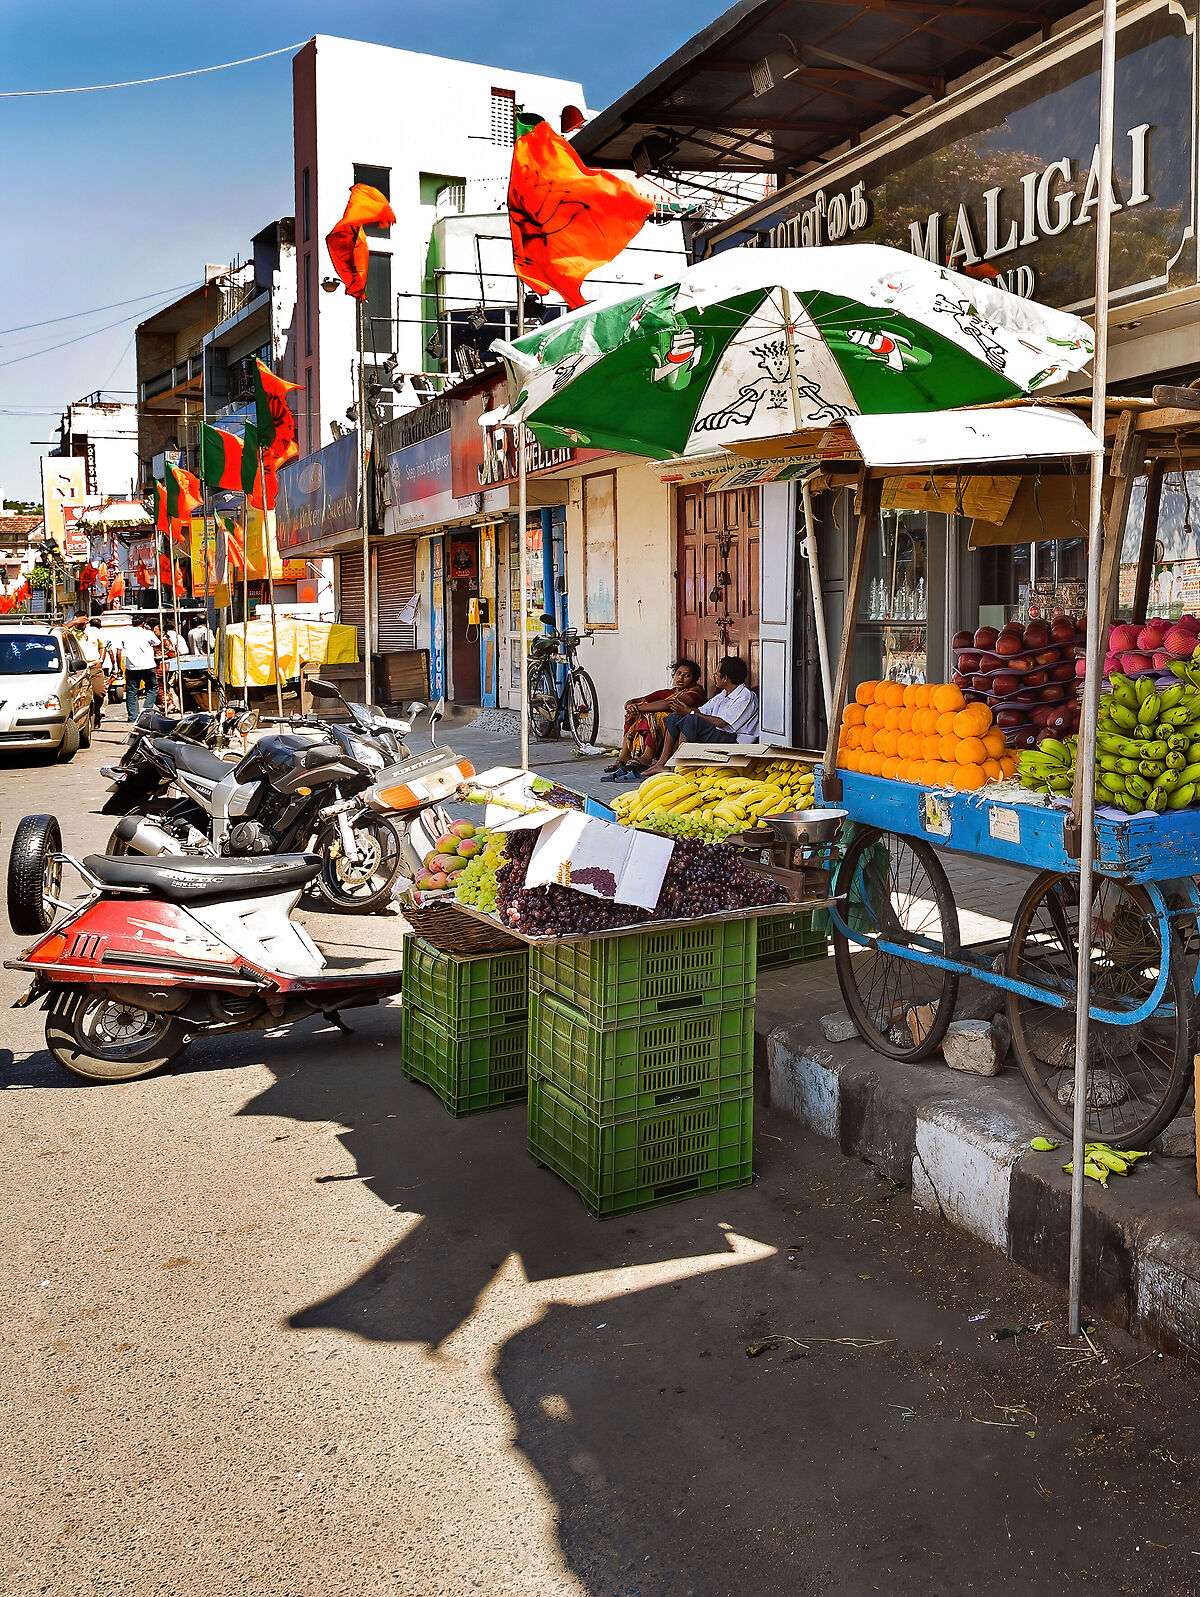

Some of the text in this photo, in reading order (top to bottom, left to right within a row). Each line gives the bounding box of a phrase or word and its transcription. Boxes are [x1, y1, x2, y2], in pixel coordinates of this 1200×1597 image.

[908, 123, 1150, 269] MALIGAI
[738, 456, 786, 469] PACKED
[788, 454, 823, 464] TRAY
[690, 464, 735, 478] APPLES
